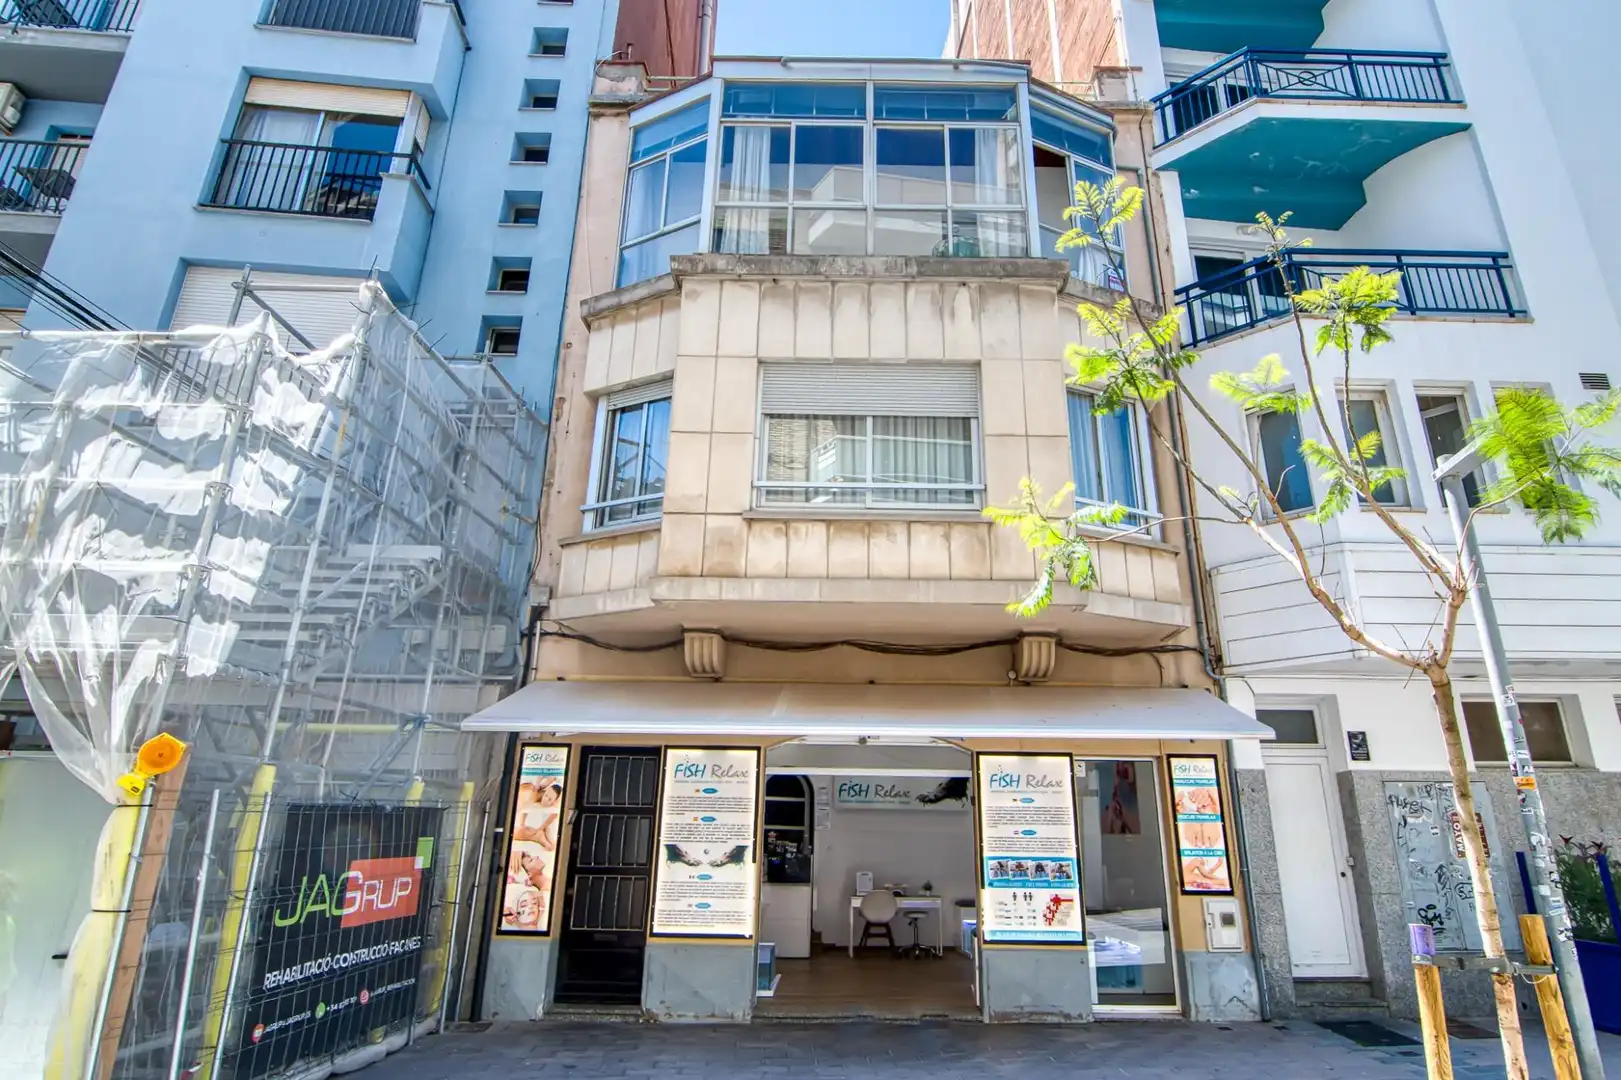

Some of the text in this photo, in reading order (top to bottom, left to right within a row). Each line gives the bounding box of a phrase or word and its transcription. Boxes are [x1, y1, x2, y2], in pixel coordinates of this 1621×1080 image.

[711, 763, 749, 779] Relax
[1026, 774, 1064, 789] Relax
[874, 783, 911, 799] Relax
